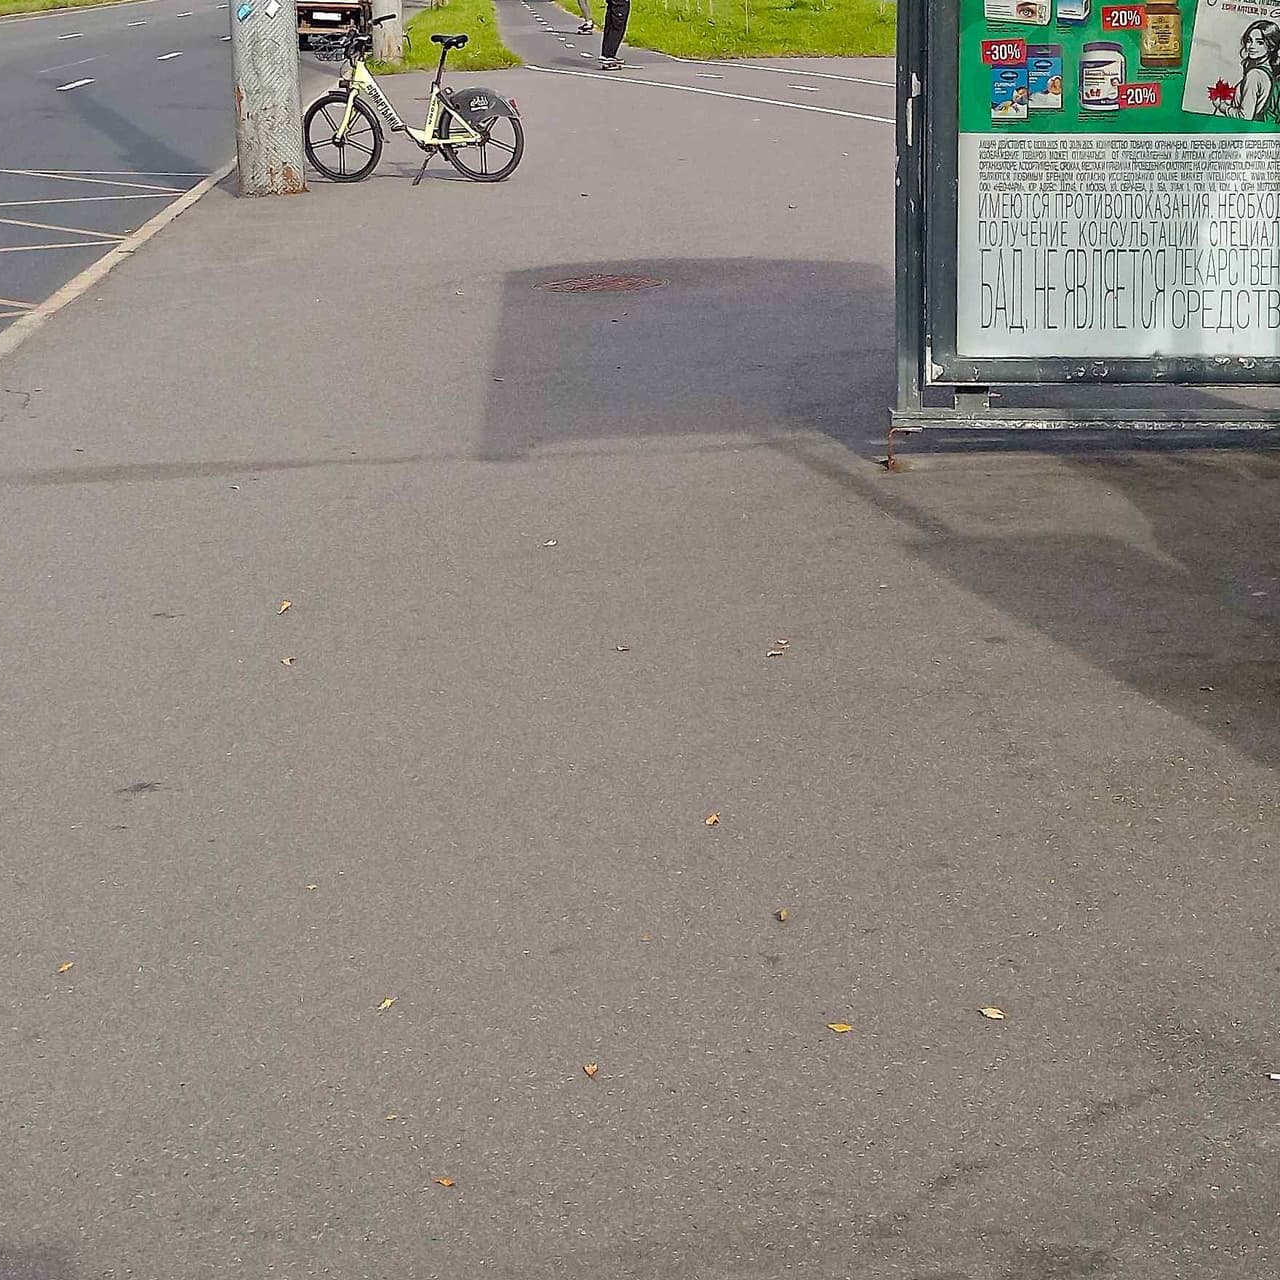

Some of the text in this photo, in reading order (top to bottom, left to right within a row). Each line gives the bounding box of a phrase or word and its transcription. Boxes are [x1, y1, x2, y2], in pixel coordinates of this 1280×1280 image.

[1105, 10, 1141, 27] -20%
[985, 44, 1021, 61] -30%
[1121, 88, 1156, 105] -20%
[978, 193, 1050, 219] ИМЕЮТСЯ
[1054, 193, 1214, 219] ПРОТИВОПОКАЗАНИЯ.
[978, 221, 1068, 247] ПОЛУЧЕНИЕ
[1079, 221, 1200, 248] КОНСУЛЬТАЦИИ
[1034, 249, 1058, 329] НЕ
[1064, 249, 1166, 329] ЯВЛЯЕТСЯ
